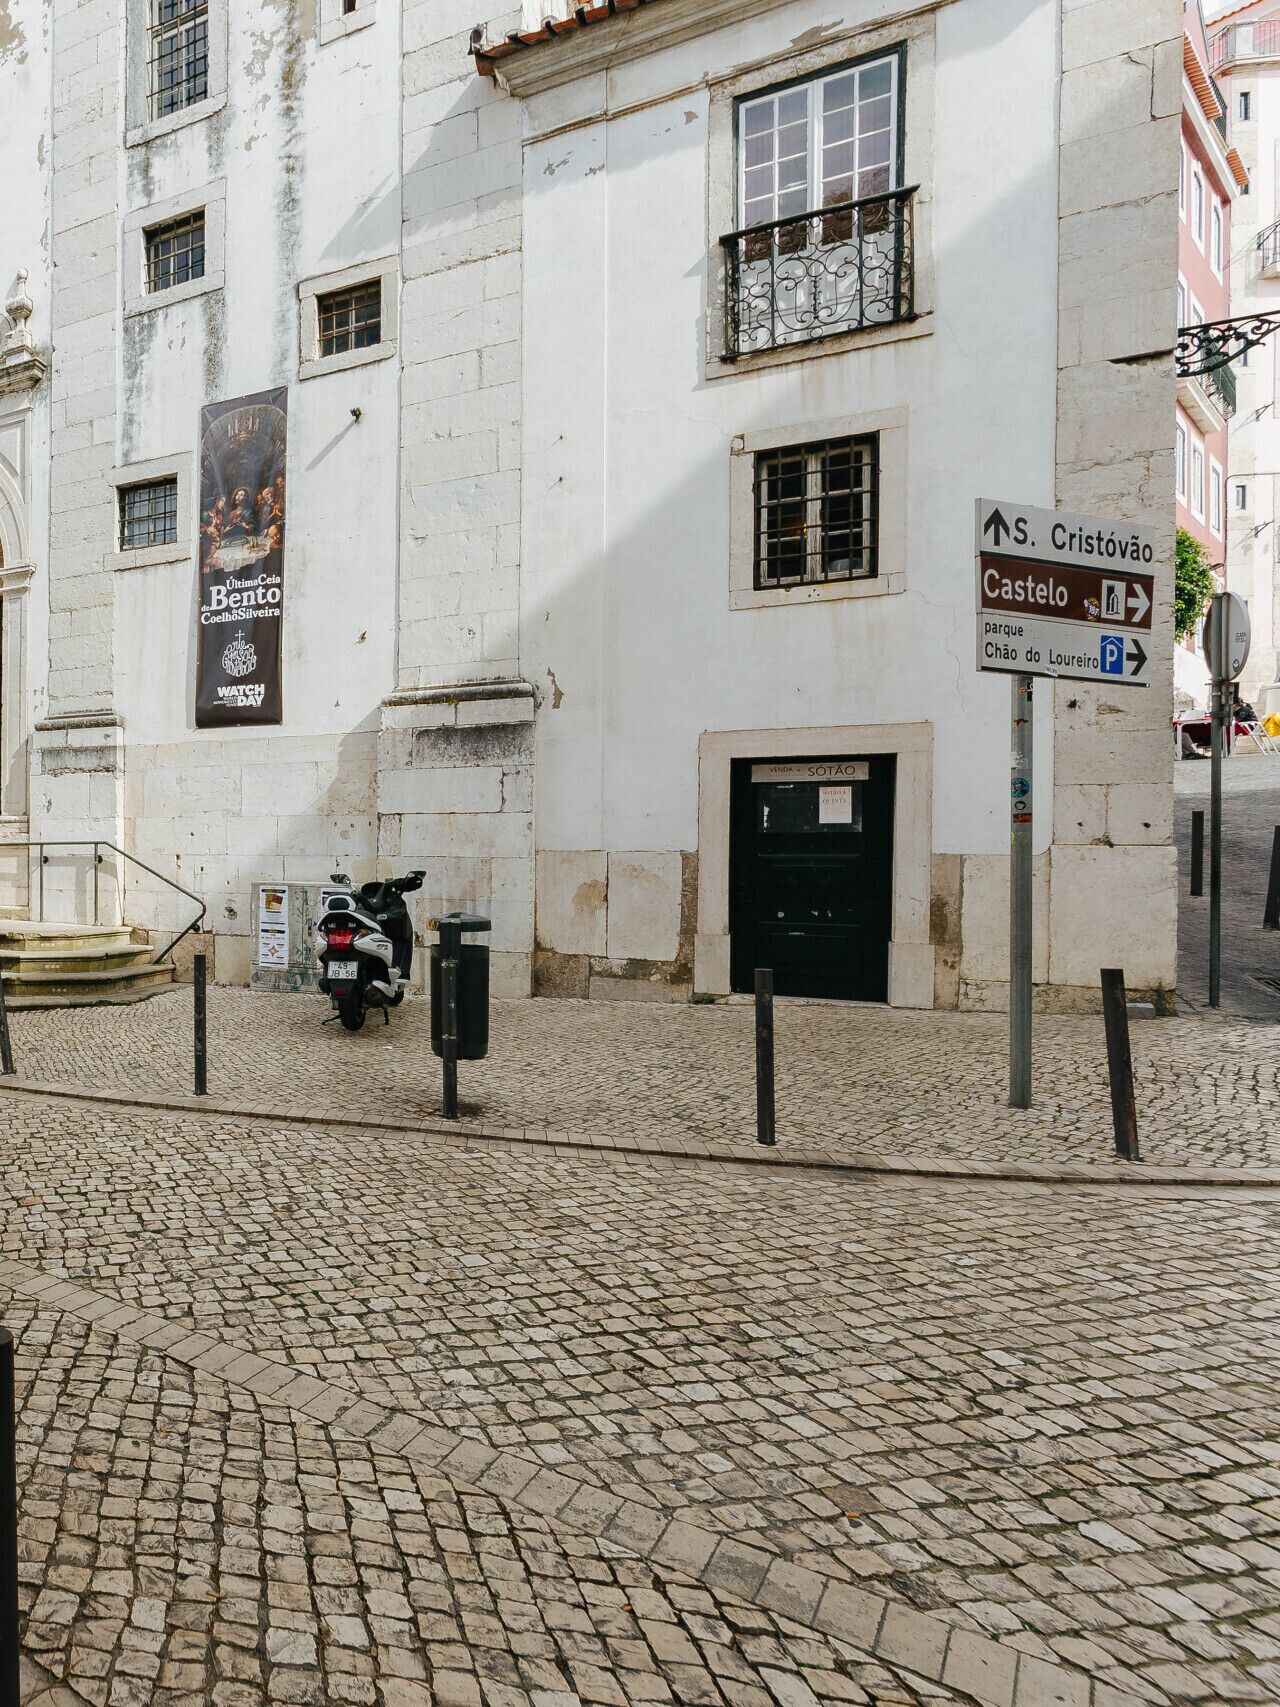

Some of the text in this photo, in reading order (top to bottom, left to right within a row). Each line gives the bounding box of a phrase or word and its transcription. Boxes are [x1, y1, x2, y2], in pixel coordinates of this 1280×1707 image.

[1013, 517, 1153, 563] S. Cristóvão
[226, 574, 281, 590] Última Ceia
[983, 568, 1068, 607] Castelo
[210, 585, 281, 611] Bento
[201, 606, 281, 625] Coelho Silveira
[984, 621, 1024, 637] parque
[984, 641, 1099, 669] Chão do Loureiro
[1106, 644, 1118, 671] P
[217, 684, 265, 697] WATCH
[237, 695, 264, 707] DAY
[808, 764, 856, 777] SÓTÃO
[338, 962, 348, 970] 49
